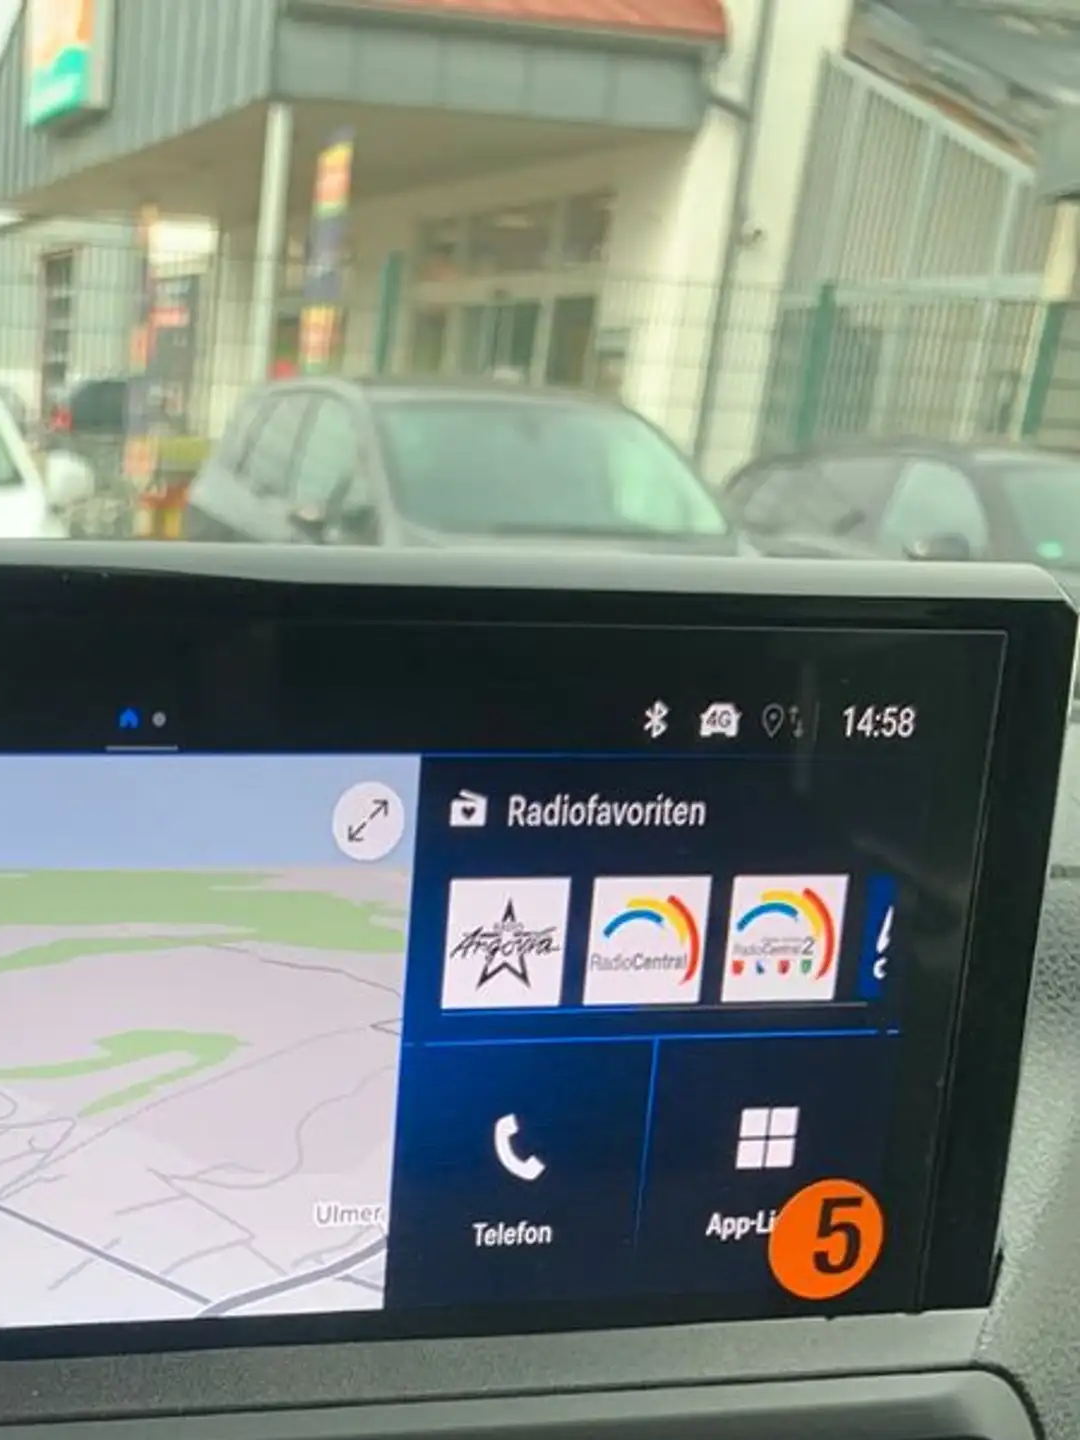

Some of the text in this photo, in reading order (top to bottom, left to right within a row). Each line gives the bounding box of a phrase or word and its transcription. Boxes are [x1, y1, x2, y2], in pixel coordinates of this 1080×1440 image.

[842, 705, 917, 738] 14:58
[507, 795, 707, 828] Radiofavoriten
[590, 953, 688, 972] RadioCentral
[315, 1203, 383, 1225] Ulmer
[705, 1210, 777, 1241] App-Li
[472, 1221, 553, 1248] Telefon
[812, 1196, 864, 1274] 5
